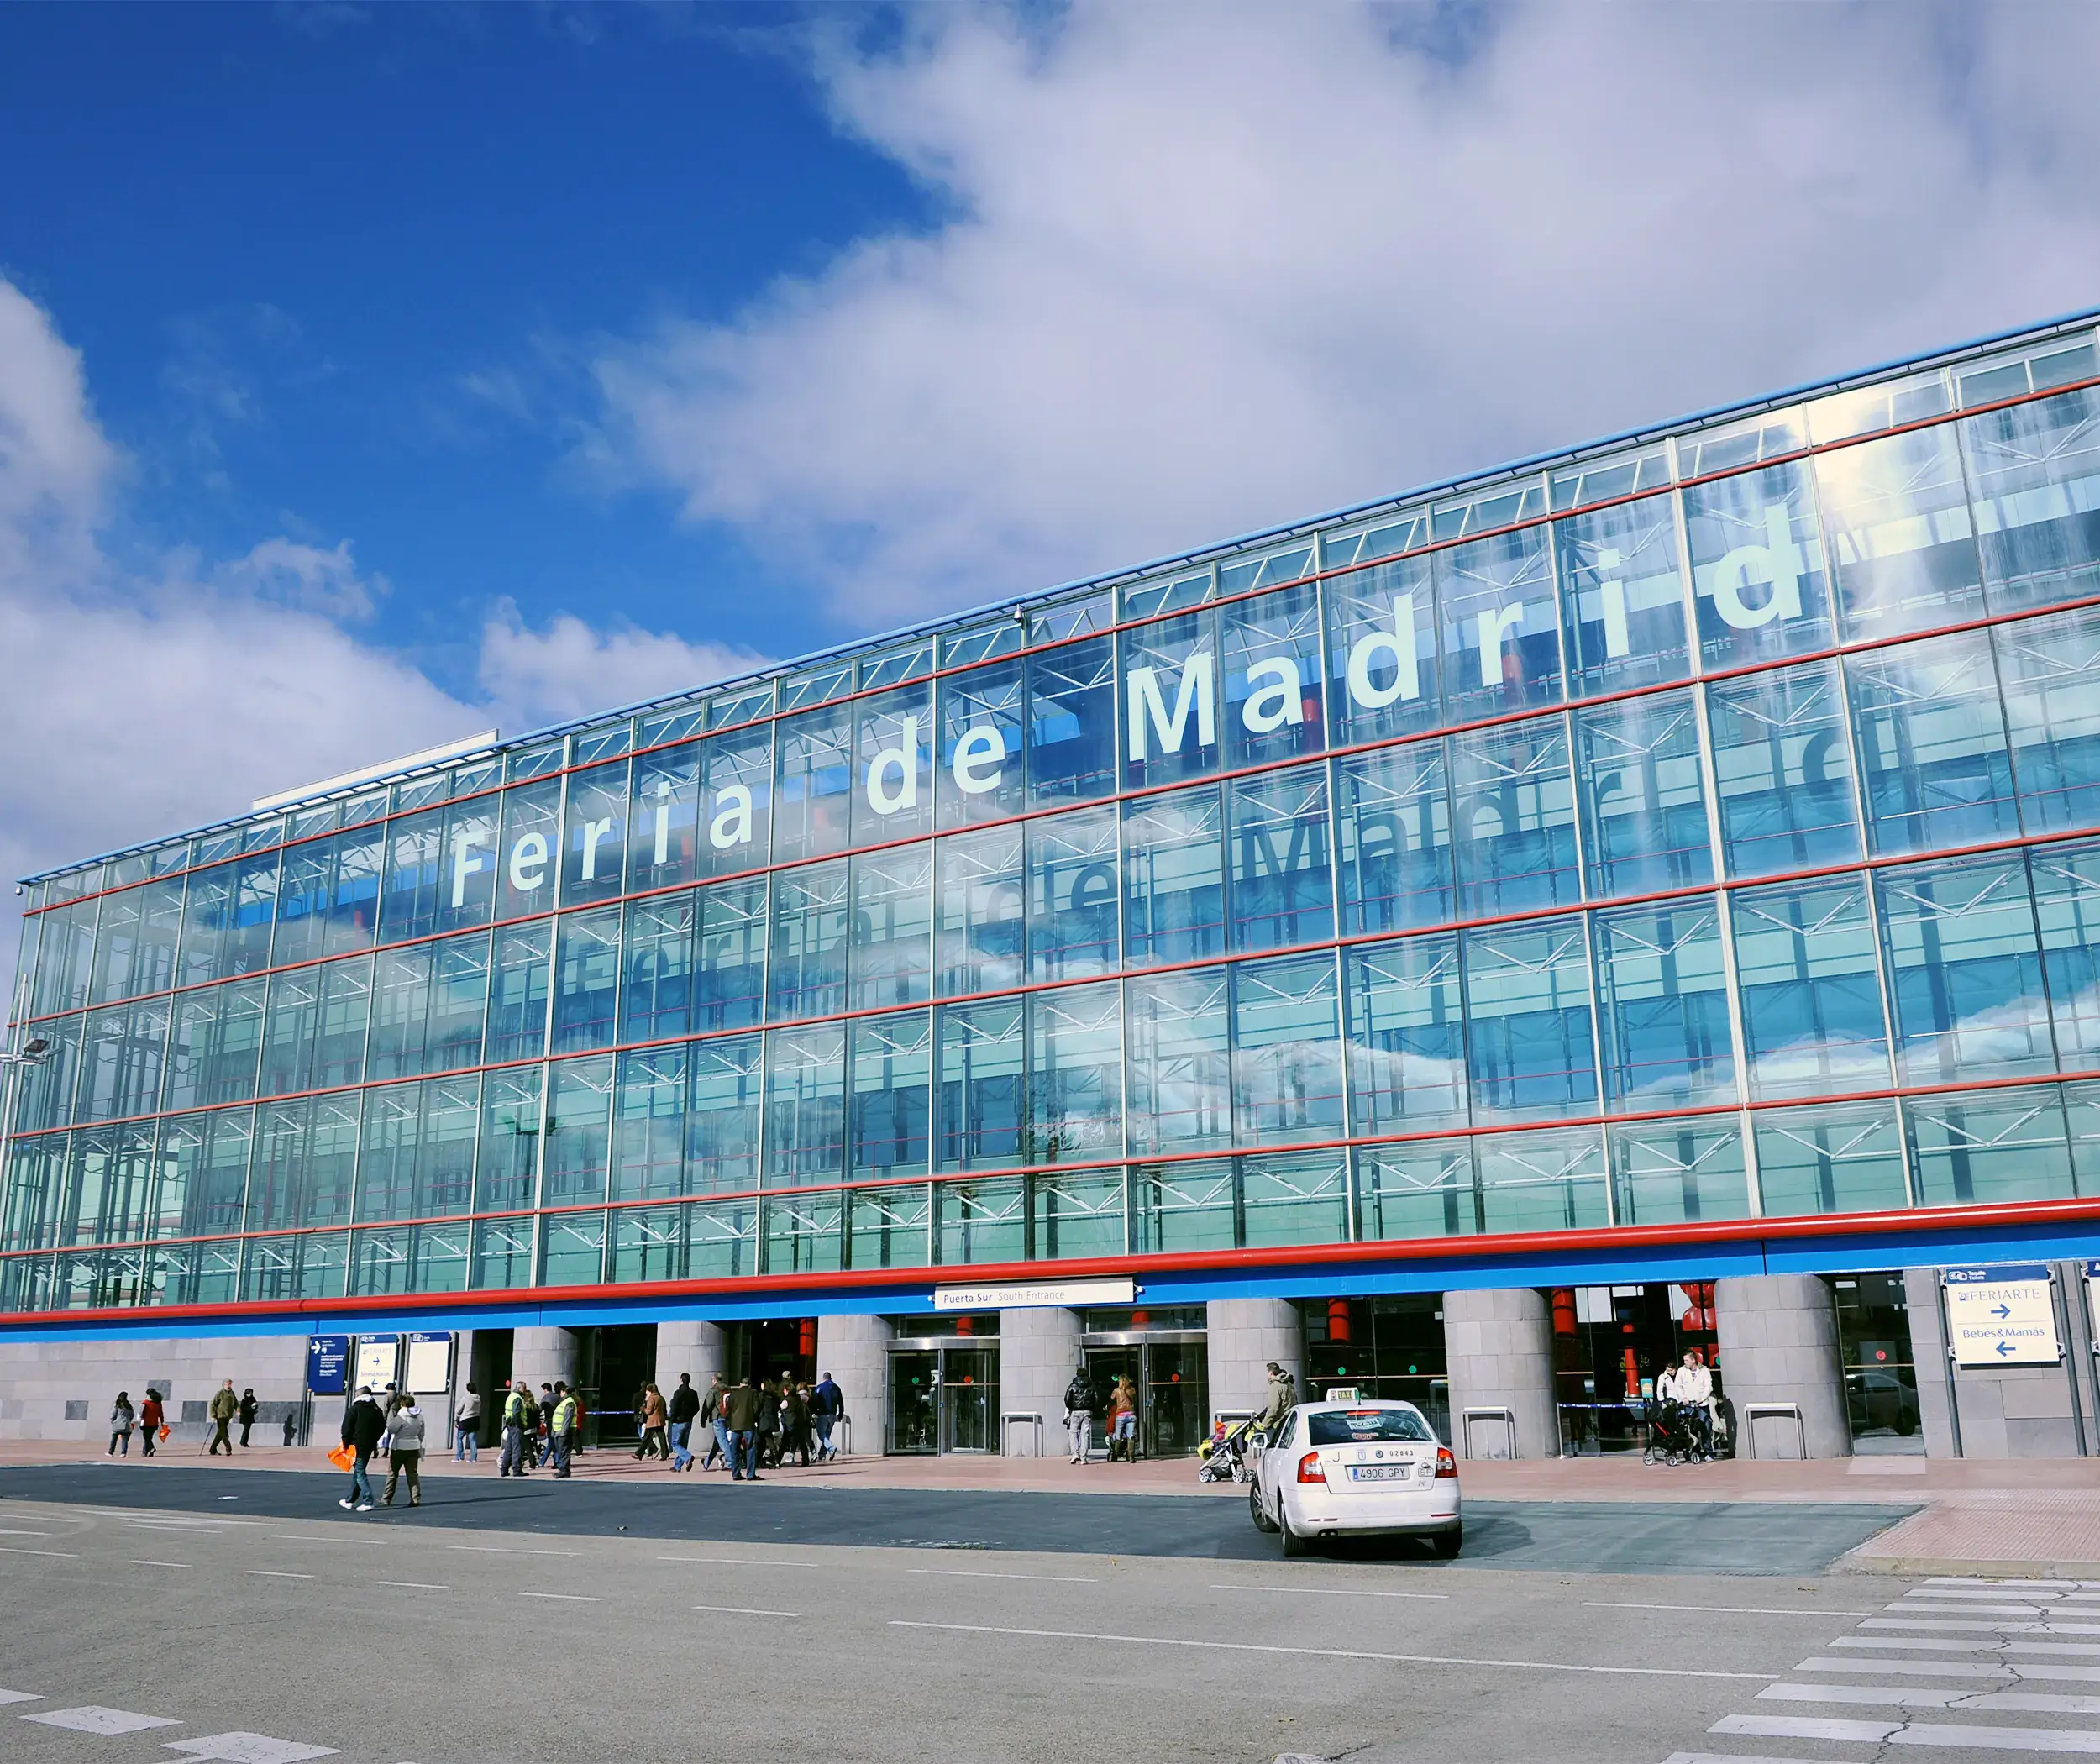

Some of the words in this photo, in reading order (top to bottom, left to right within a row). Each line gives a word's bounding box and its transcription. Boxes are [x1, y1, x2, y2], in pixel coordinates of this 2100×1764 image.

[451, 780, 753, 908] Feria
[866, 715, 1005, 816] de
[1127, 503, 1802, 762] Madrid
[943, 1294, 974, 1303] Puerta
[977, 1293, 993, 1302] Sur
[998, 1291, 1023, 1301] South
[1026, 1290, 1065, 1300] Entrance
[1970, 1288, 2041, 1301] FERIARTE
[1963, 1328, 2045, 1339] Bebés&Mamás
[1360, 1467, 1384, 1479] 4906
[1388, 1467, 1406, 1478] GPY
